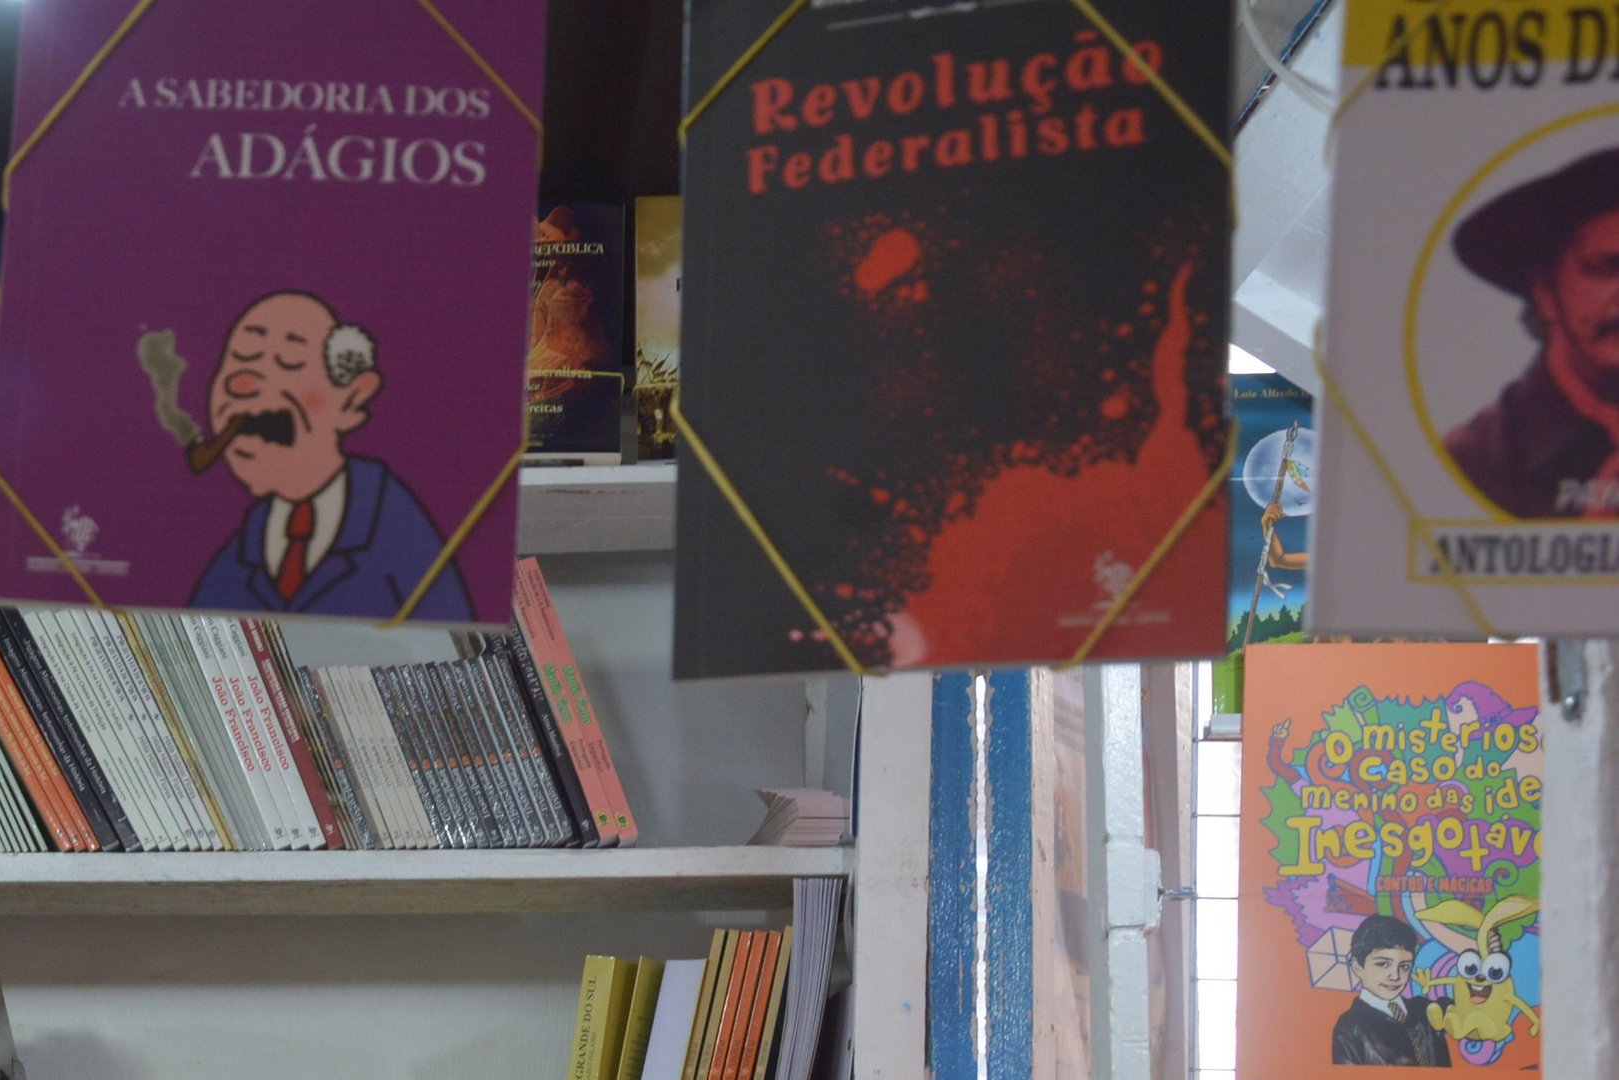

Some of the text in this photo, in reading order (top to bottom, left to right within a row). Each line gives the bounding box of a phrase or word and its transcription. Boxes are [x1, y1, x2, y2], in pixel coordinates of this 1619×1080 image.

[751, 29, 1164, 134] Revolução
[1375, 10, 1546, 90] ANOS
[119, 77, 491, 119] A SABEDORIA DOS
[190, 123, 486, 186] ADÁGIOS
[747, 104, 1146, 193] Federalista
[211, 676, 256, 771] João Francisco
[229, 677, 273, 771] João Francisco
[247, 675, 290, 770] João Francisco
[1302, 785, 1474, 814] menino das
[1358, 755, 1500, 784] caso do
[581, 1002, 594, 1022] DO
[583, 975, 598, 1000] SUL
[574, 1025, 591, 1080] GRANDE
